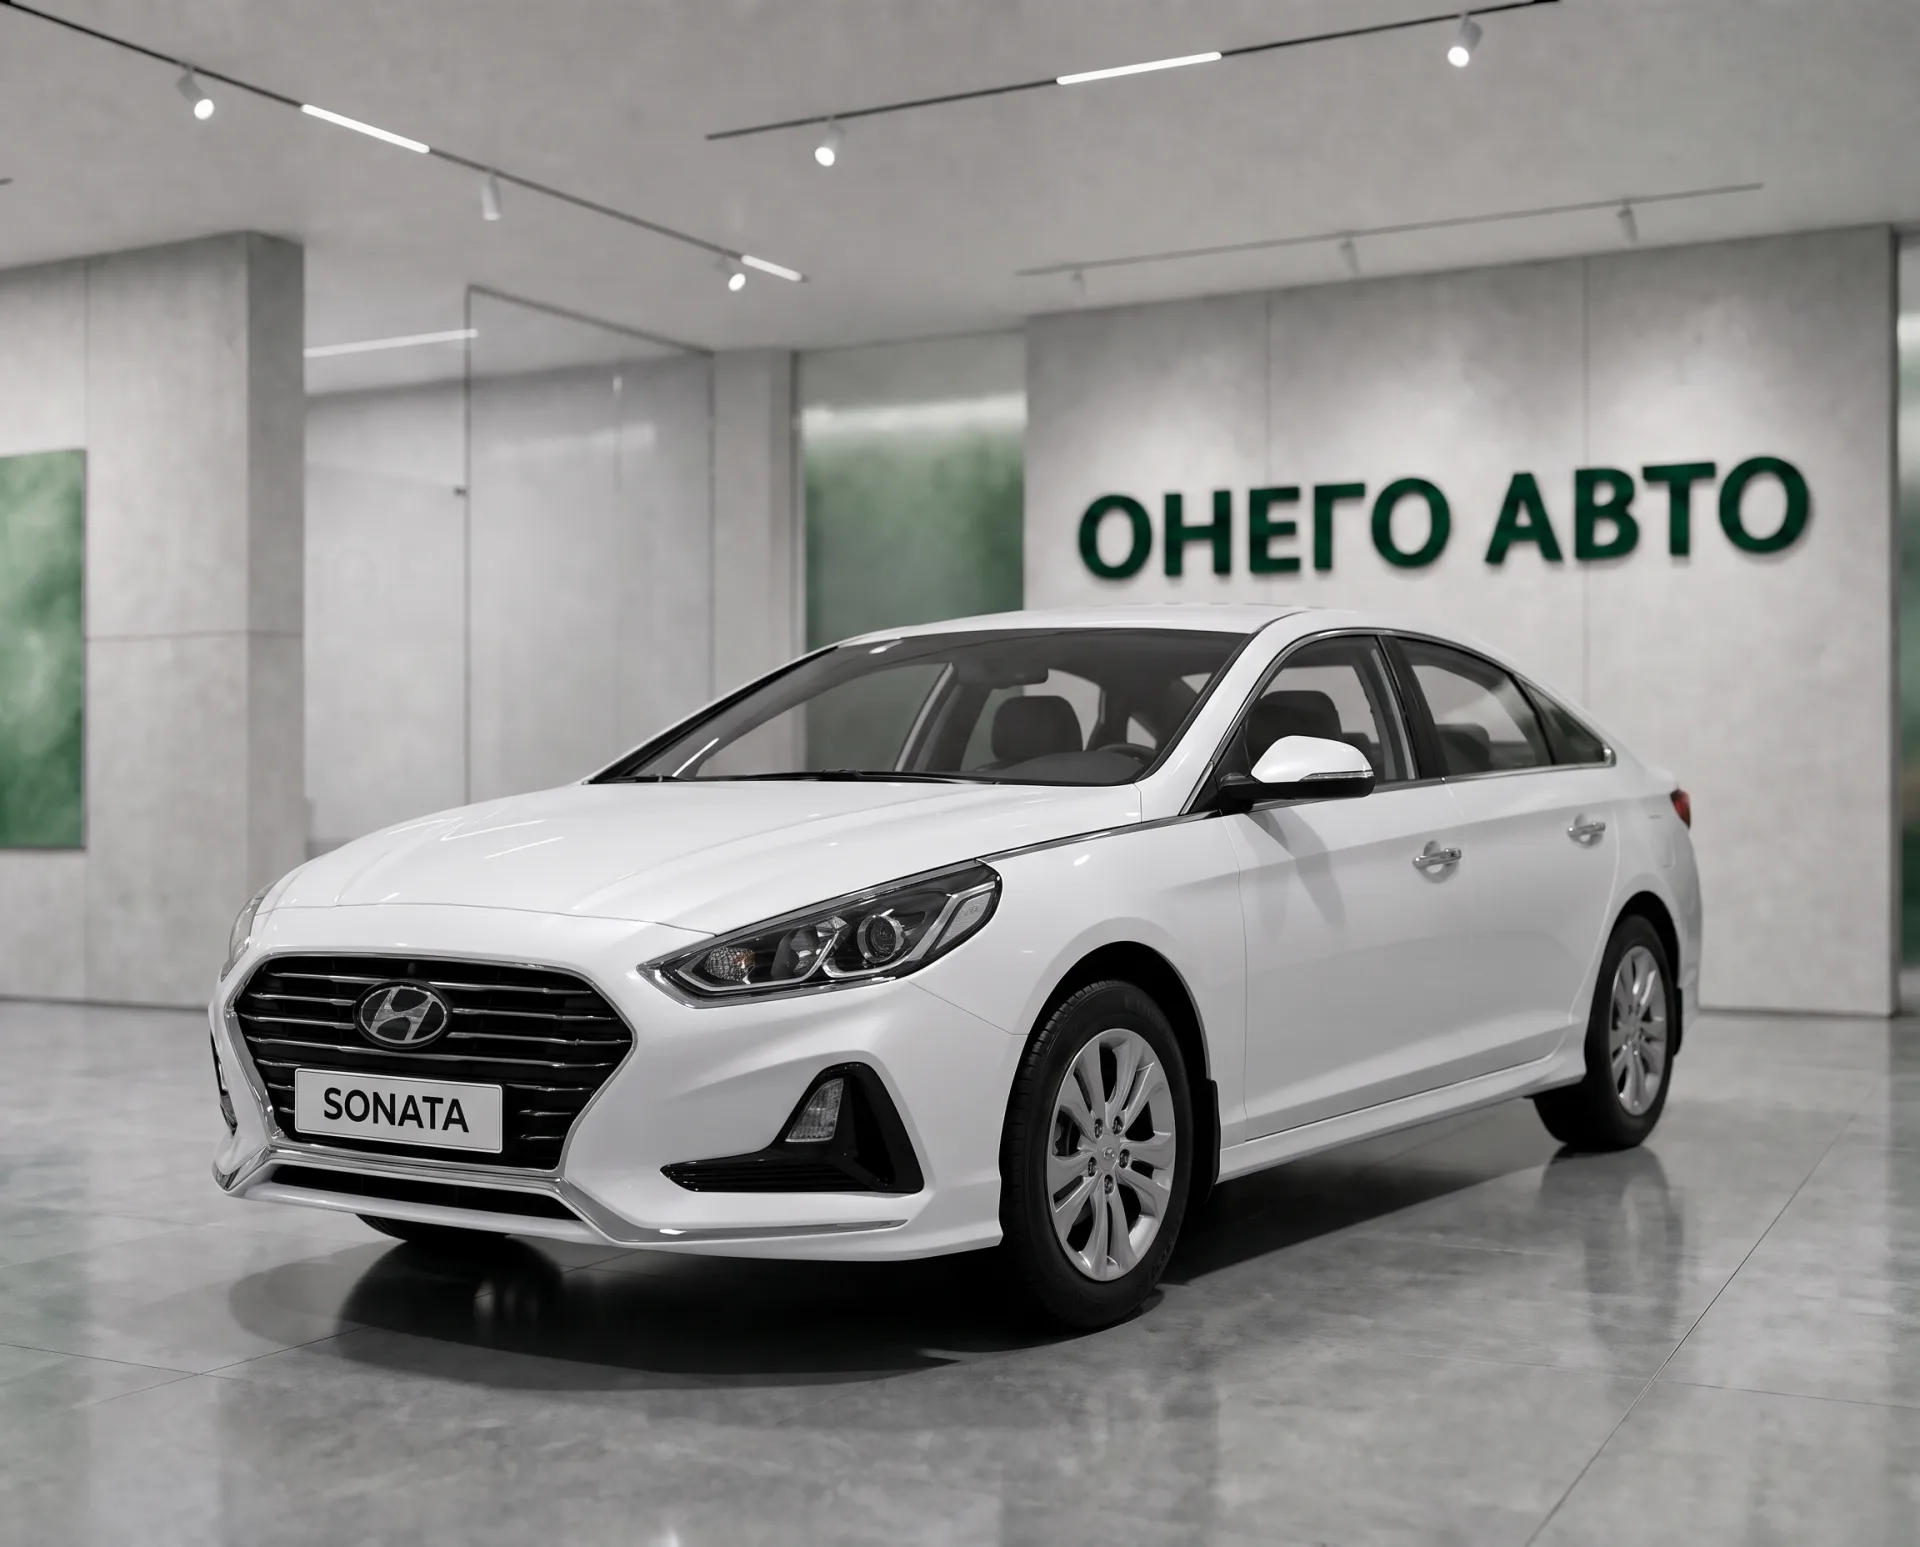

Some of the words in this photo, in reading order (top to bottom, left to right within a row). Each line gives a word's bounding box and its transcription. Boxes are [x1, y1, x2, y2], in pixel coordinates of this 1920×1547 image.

[1079, 477, 1451, 579] ОНЕГО
[1486, 456, 1811, 565] АВТО
[323, 1087, 469, 1133] SONATA
